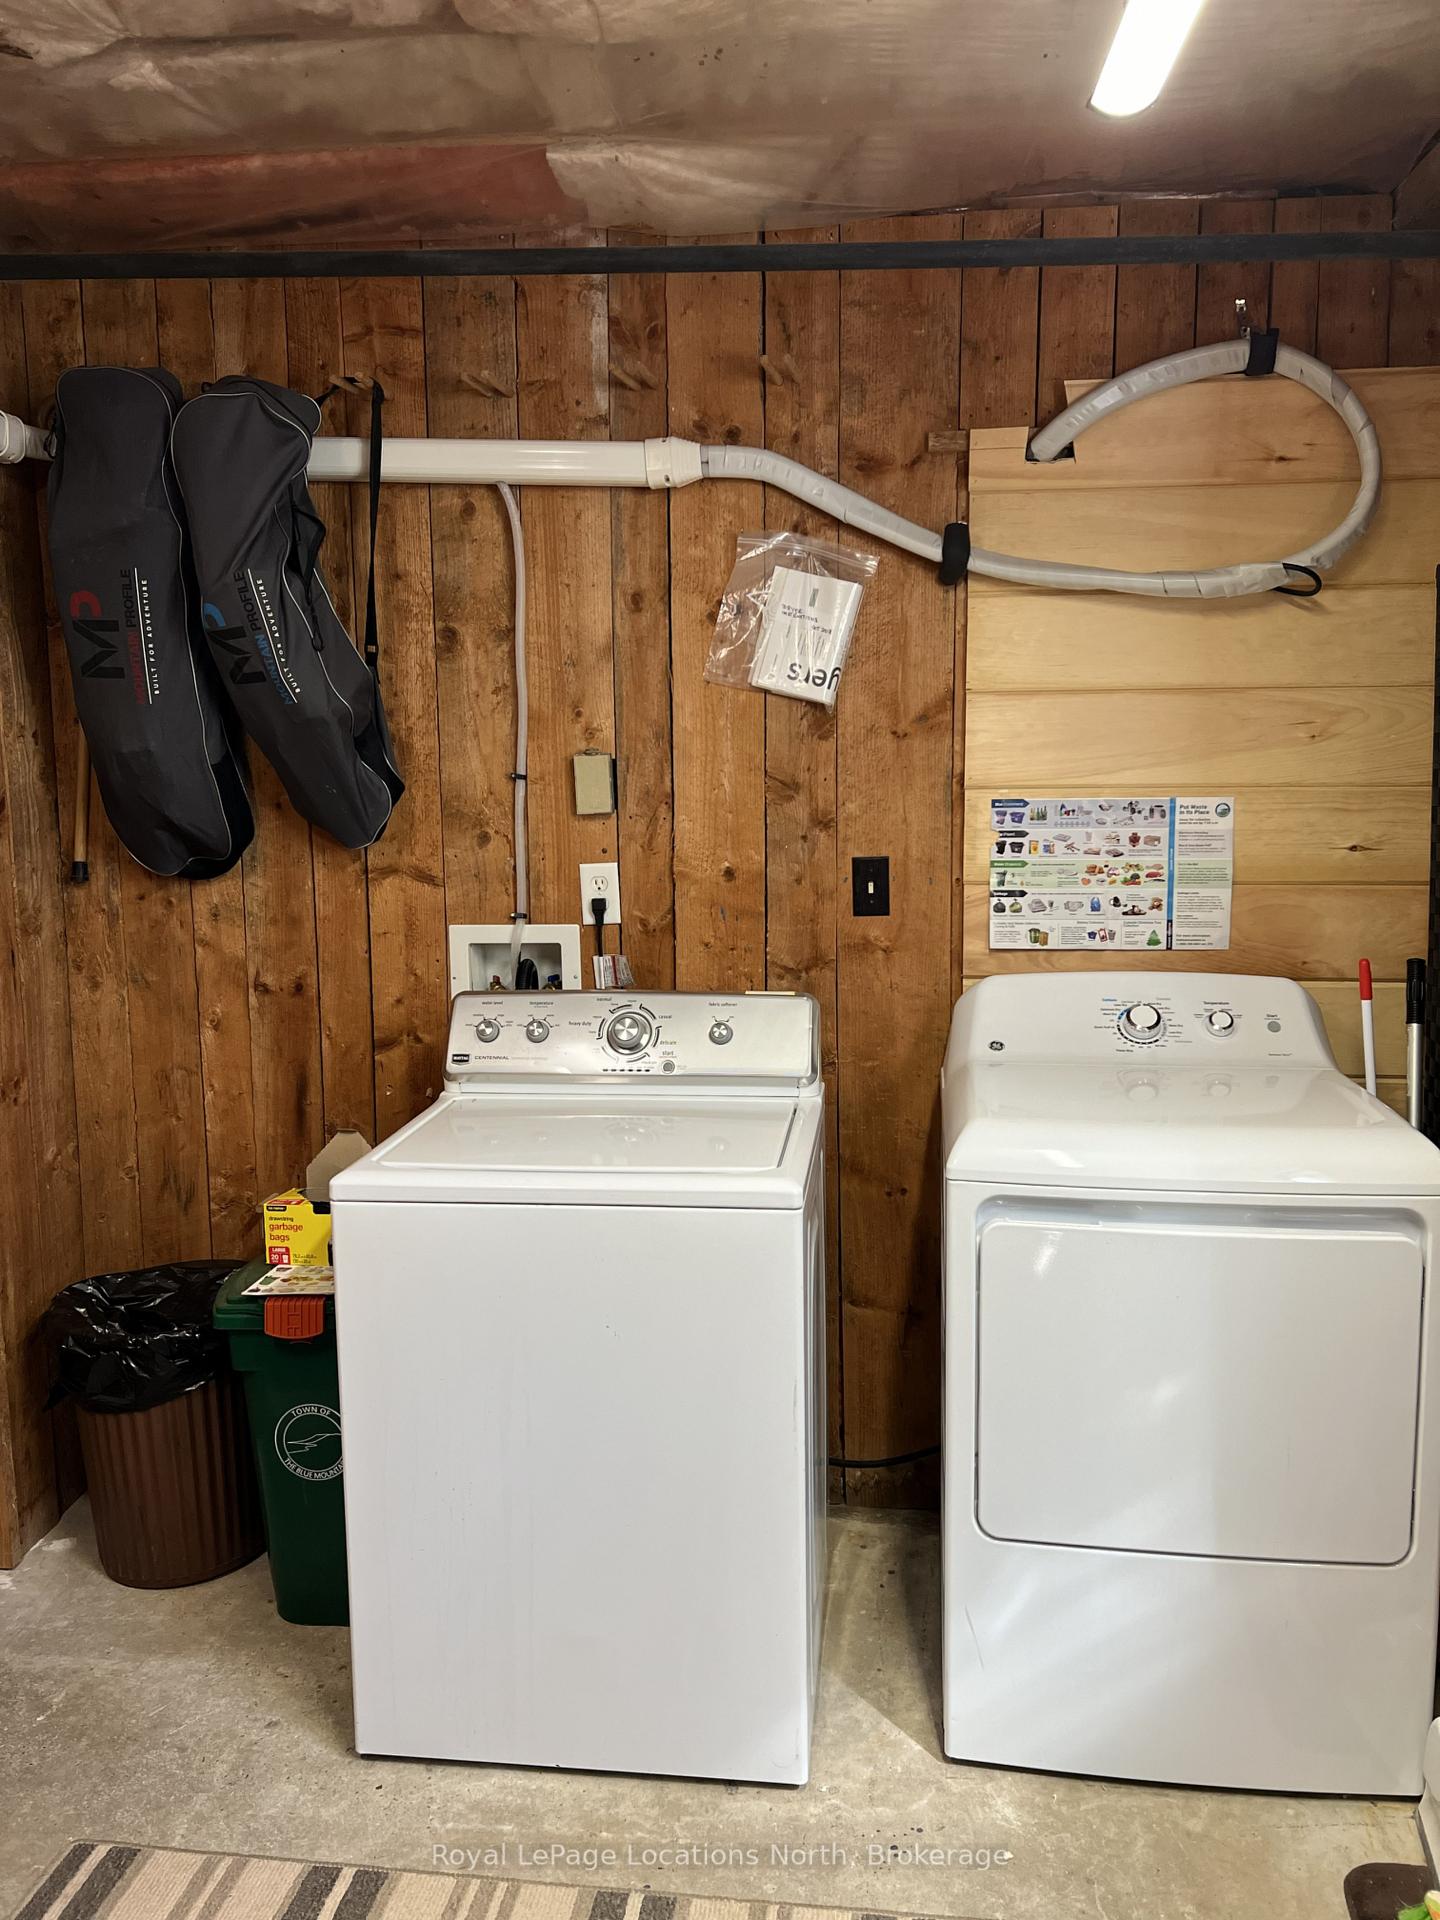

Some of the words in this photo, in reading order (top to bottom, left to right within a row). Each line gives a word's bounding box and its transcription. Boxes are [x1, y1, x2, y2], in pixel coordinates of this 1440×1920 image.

[120, 569, 136, 628] PROFILE
[141, 579, 153, 638] ADVENTURE
[233, 571, 262, 632] PROFILE
[256, 579, 280, 638] ADVENTURE
[277, 643, 286, 662] FOR
[128, 631, 145, 704] MOUNTAIN
[151, 667, 160, 695] BUILT
[255, 633, 295, 705] MOUNTAIN
[284, 667, 301, 693] BUILT
[269, 1222, 304, 1232] garbage
[270, 1233, 290, 1242] bags
[291, 1406, 318, 1416] TOWN
[320, 1408, 331, 1416] OF
[284, 1458, 297, 1471] THE
[296, 1467, 313, 1479] BLUE
[313, 1462, 343, 1479] MOUNTA
